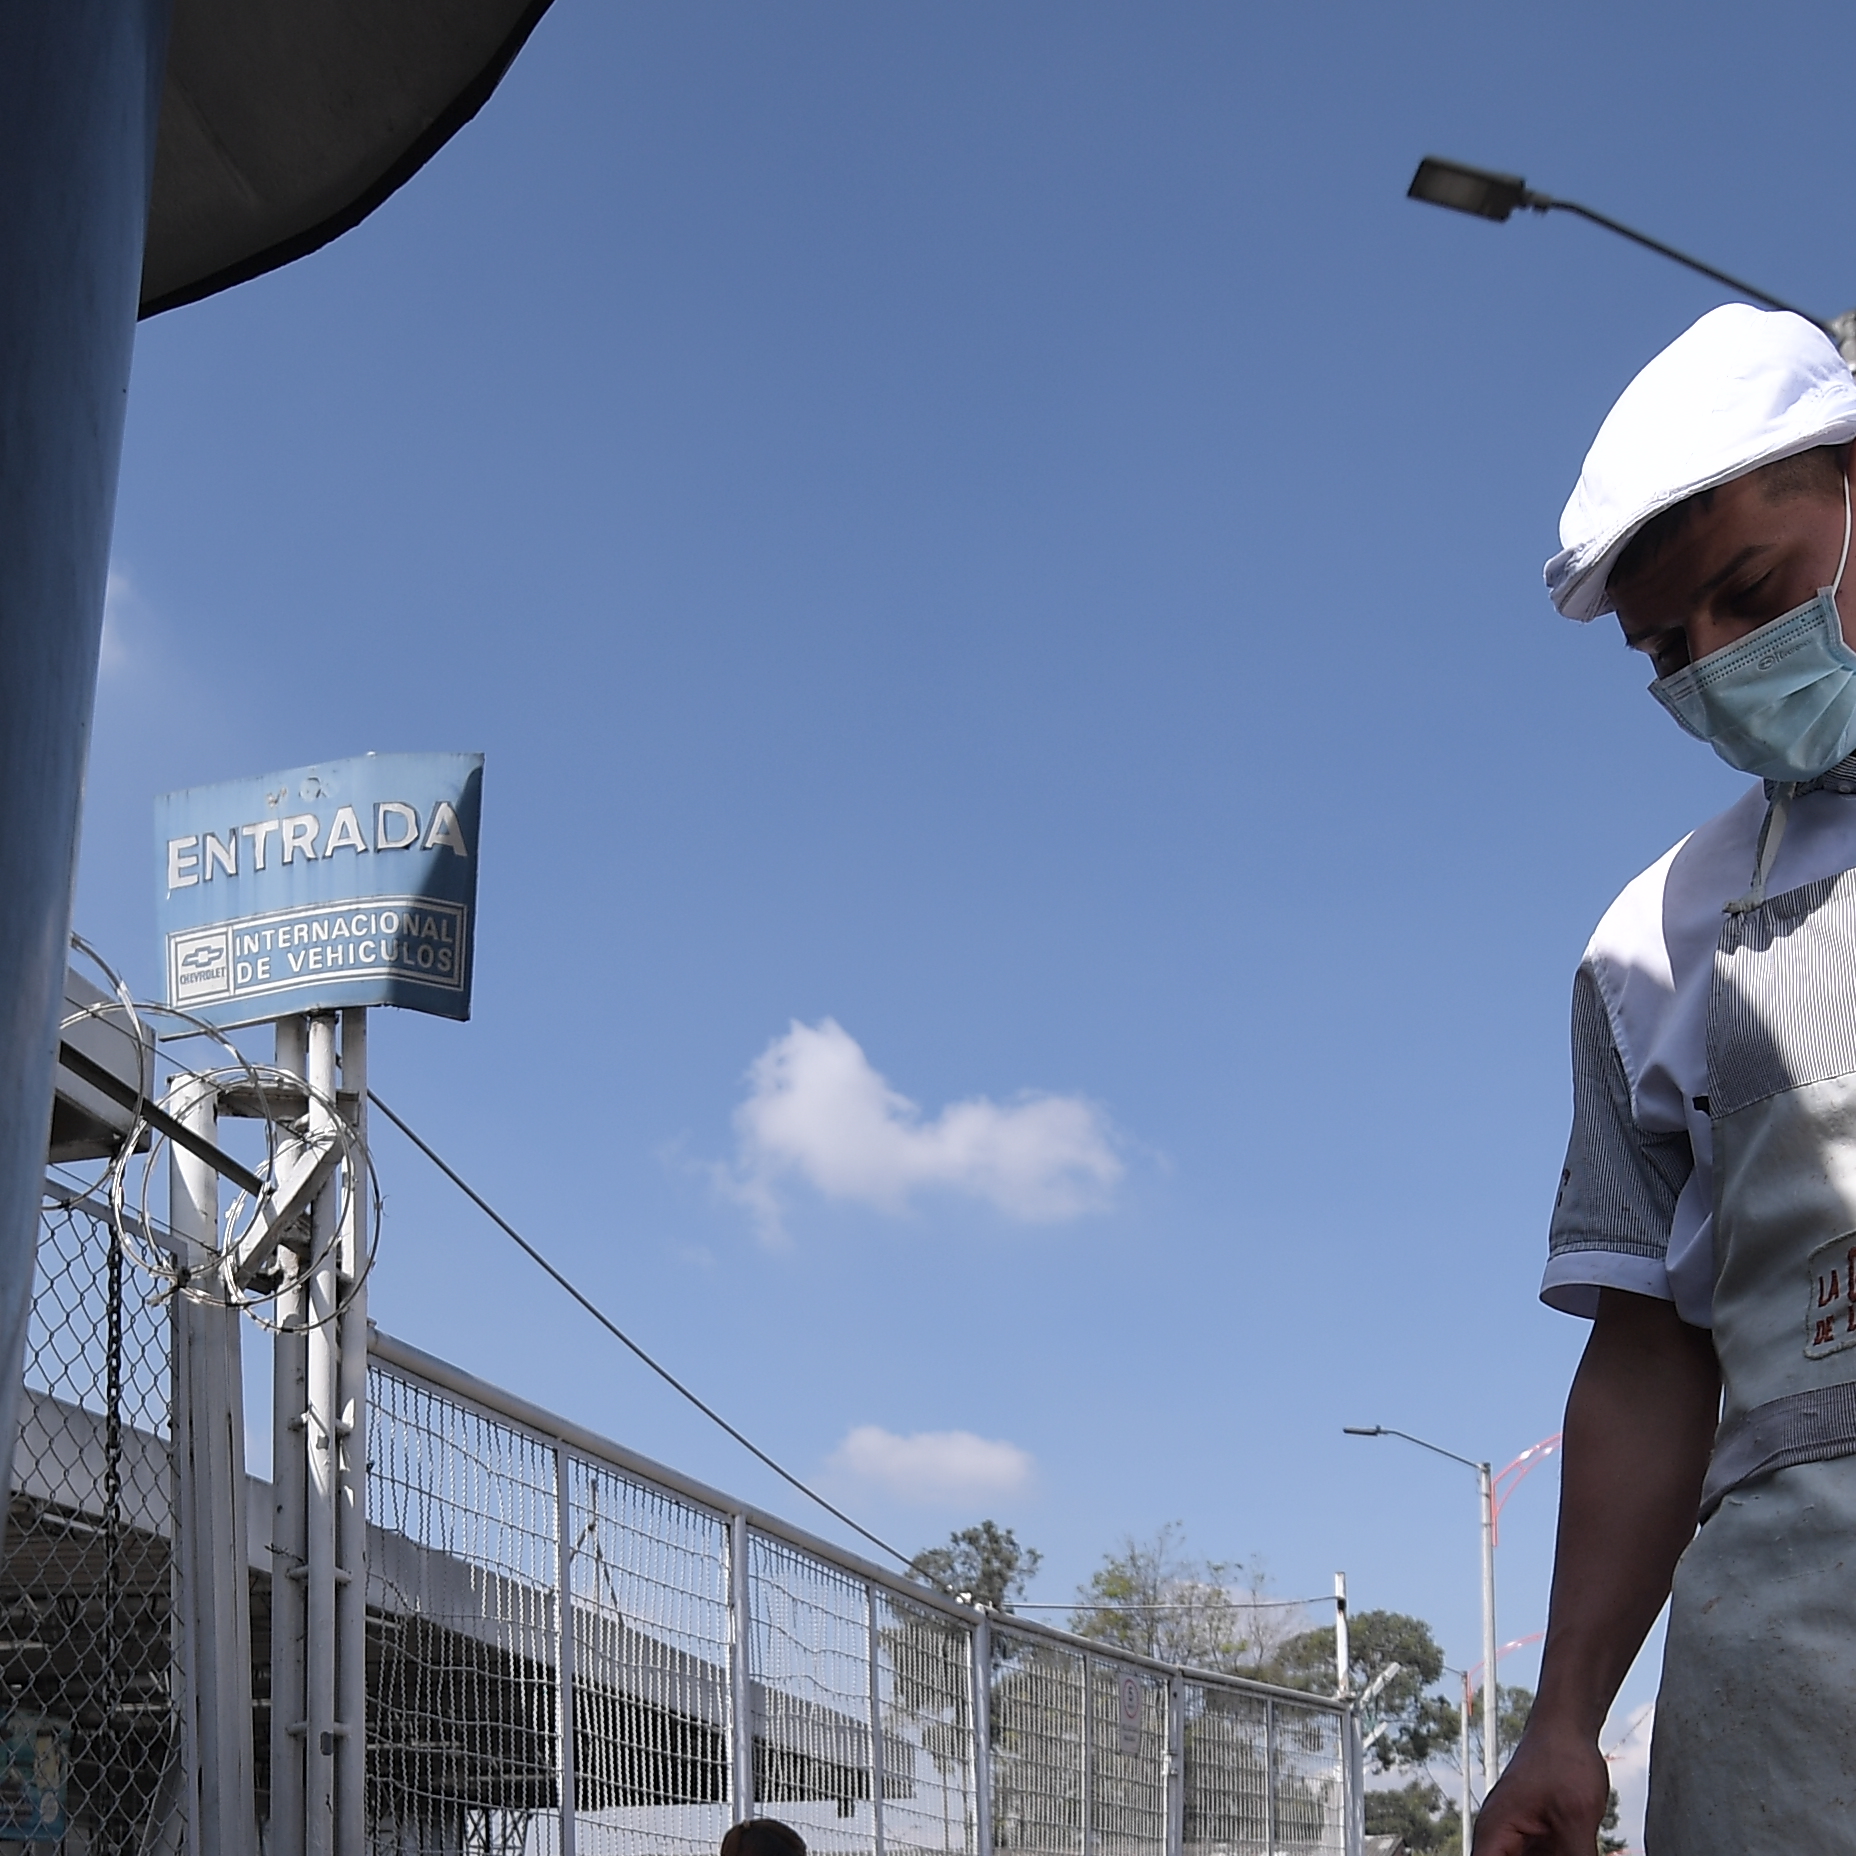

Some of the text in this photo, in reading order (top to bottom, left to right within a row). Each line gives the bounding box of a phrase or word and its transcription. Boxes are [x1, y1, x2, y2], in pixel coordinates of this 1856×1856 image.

[167, 801, 468, 890] ENTRADA
[235, 909, 455, 958] INTERNACIONAL
[179, 966, 226, 985] CHEVROLET
[236, 937, 454, 985] DE VEHICULOS
[1817, 1269, 1840, 1307] LA
[1812, 1314, 1835, 1346] DE
